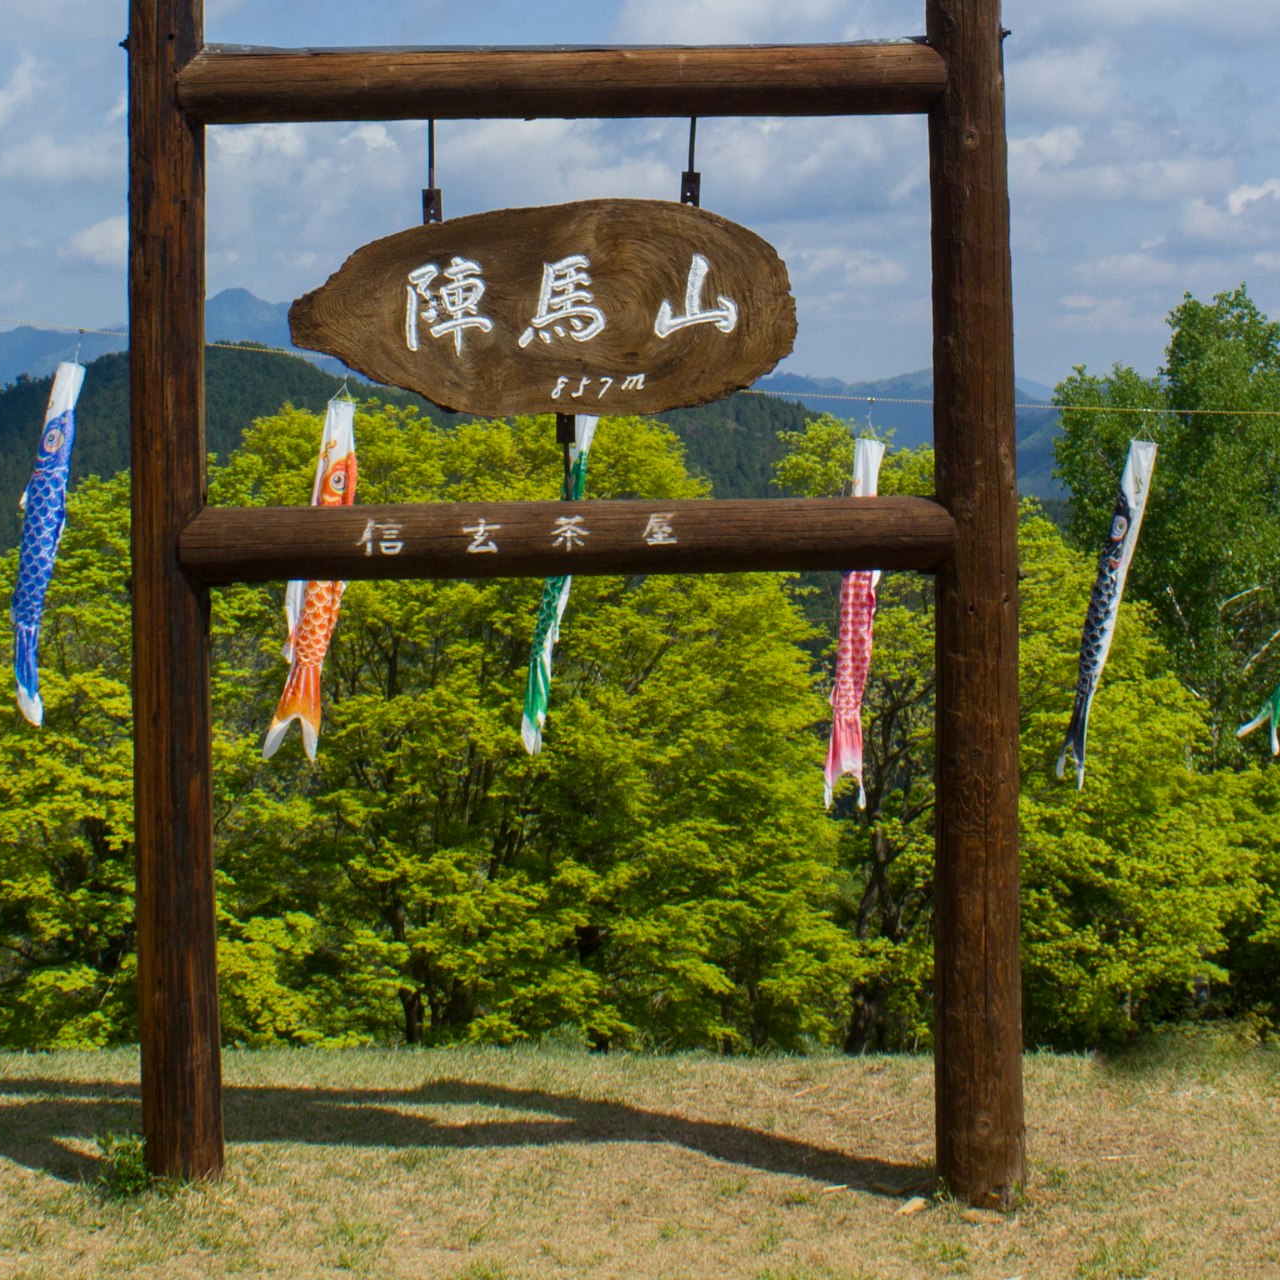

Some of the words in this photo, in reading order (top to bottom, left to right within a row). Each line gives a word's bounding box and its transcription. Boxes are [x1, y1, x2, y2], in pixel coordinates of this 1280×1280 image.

[405, 253, 739, 356] 陣馬山
[356, 512, 678, 556] 信玄茶屋
